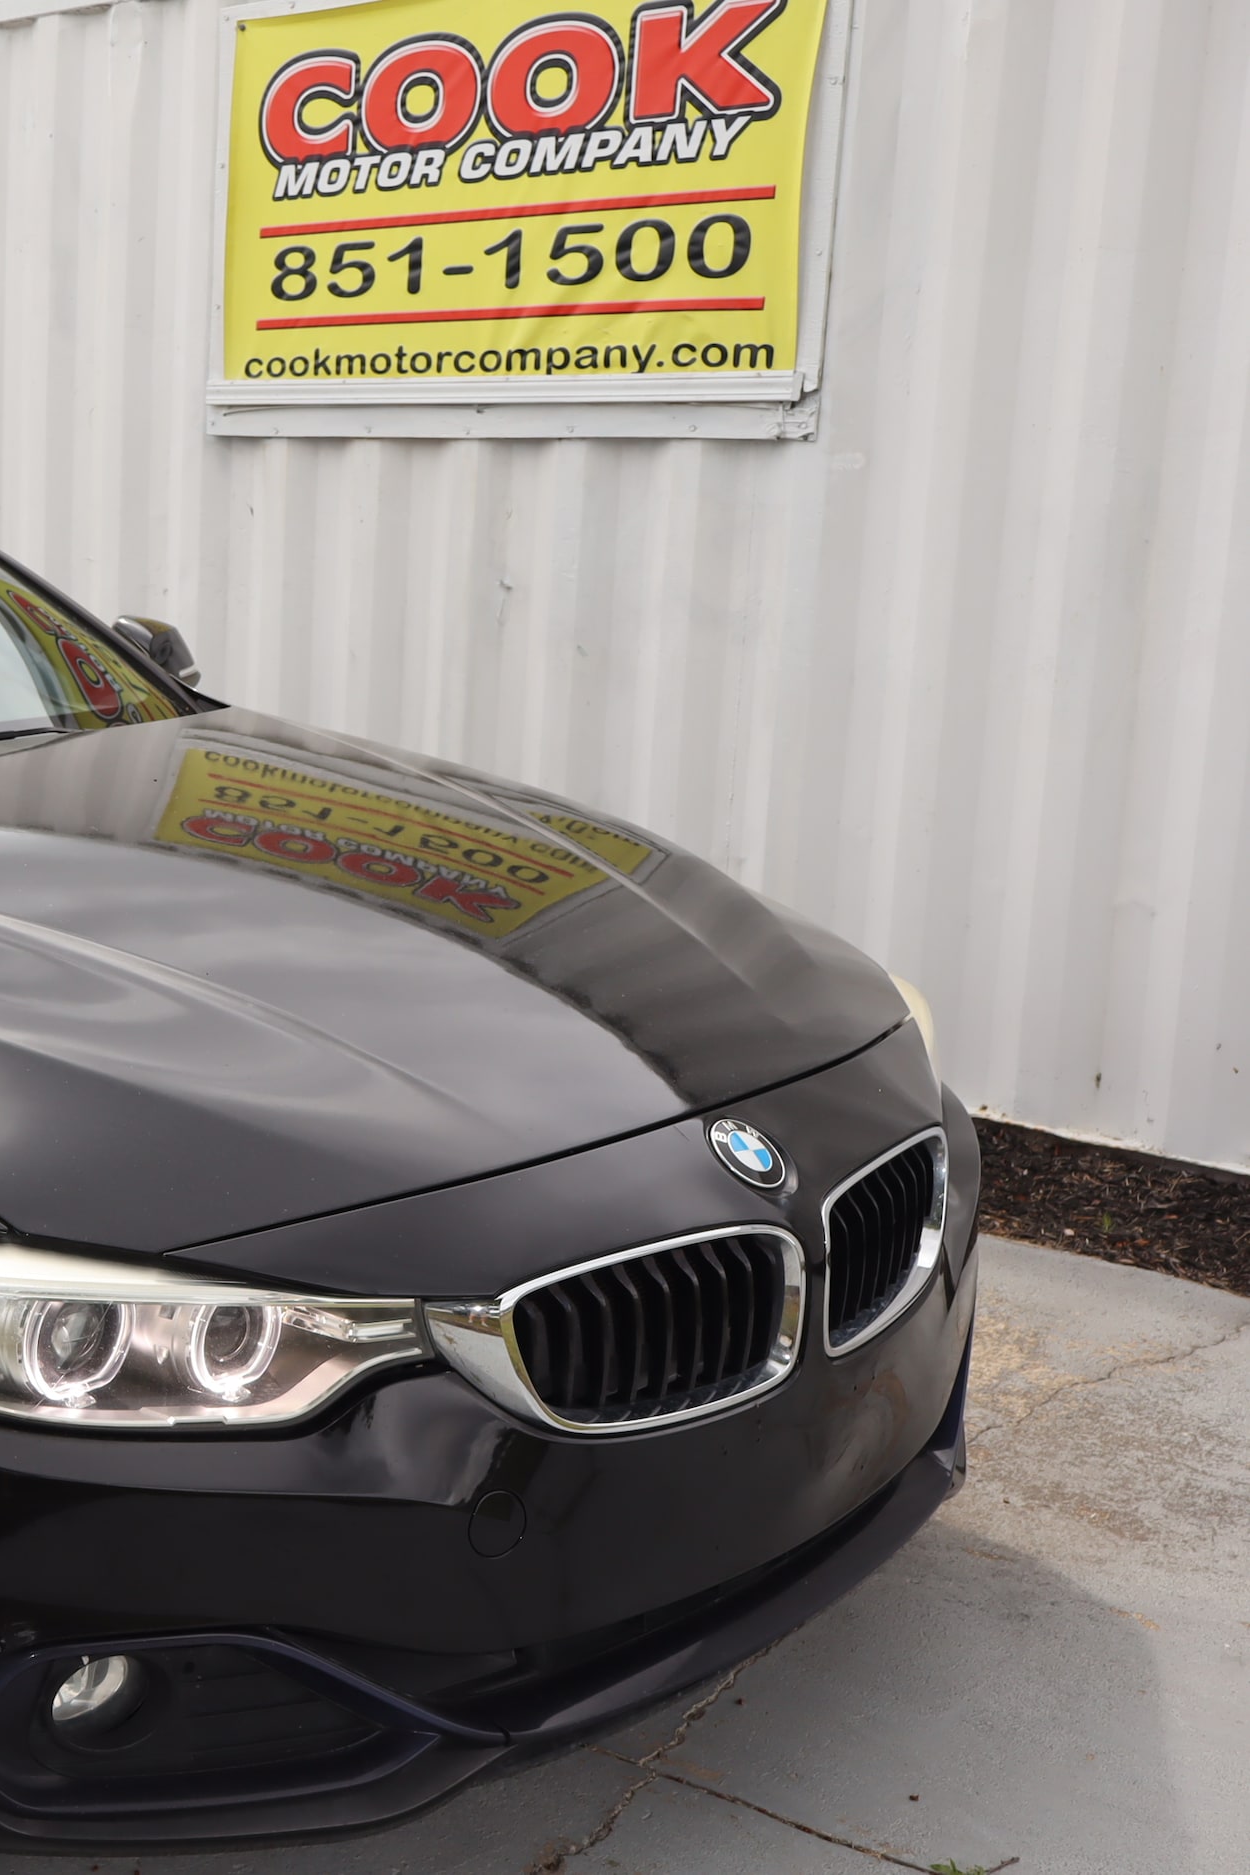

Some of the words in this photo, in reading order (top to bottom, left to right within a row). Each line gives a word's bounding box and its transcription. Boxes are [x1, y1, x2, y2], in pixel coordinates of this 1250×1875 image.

[259, 0, 787, 167] COOK
[273, 149, 447, 200] MOTOR
[458, 115, 752, 183] COMPANY
[270, 213, 751, 301] 851-1500
[244, 341, 775, 376] cookmotorcompany.com
